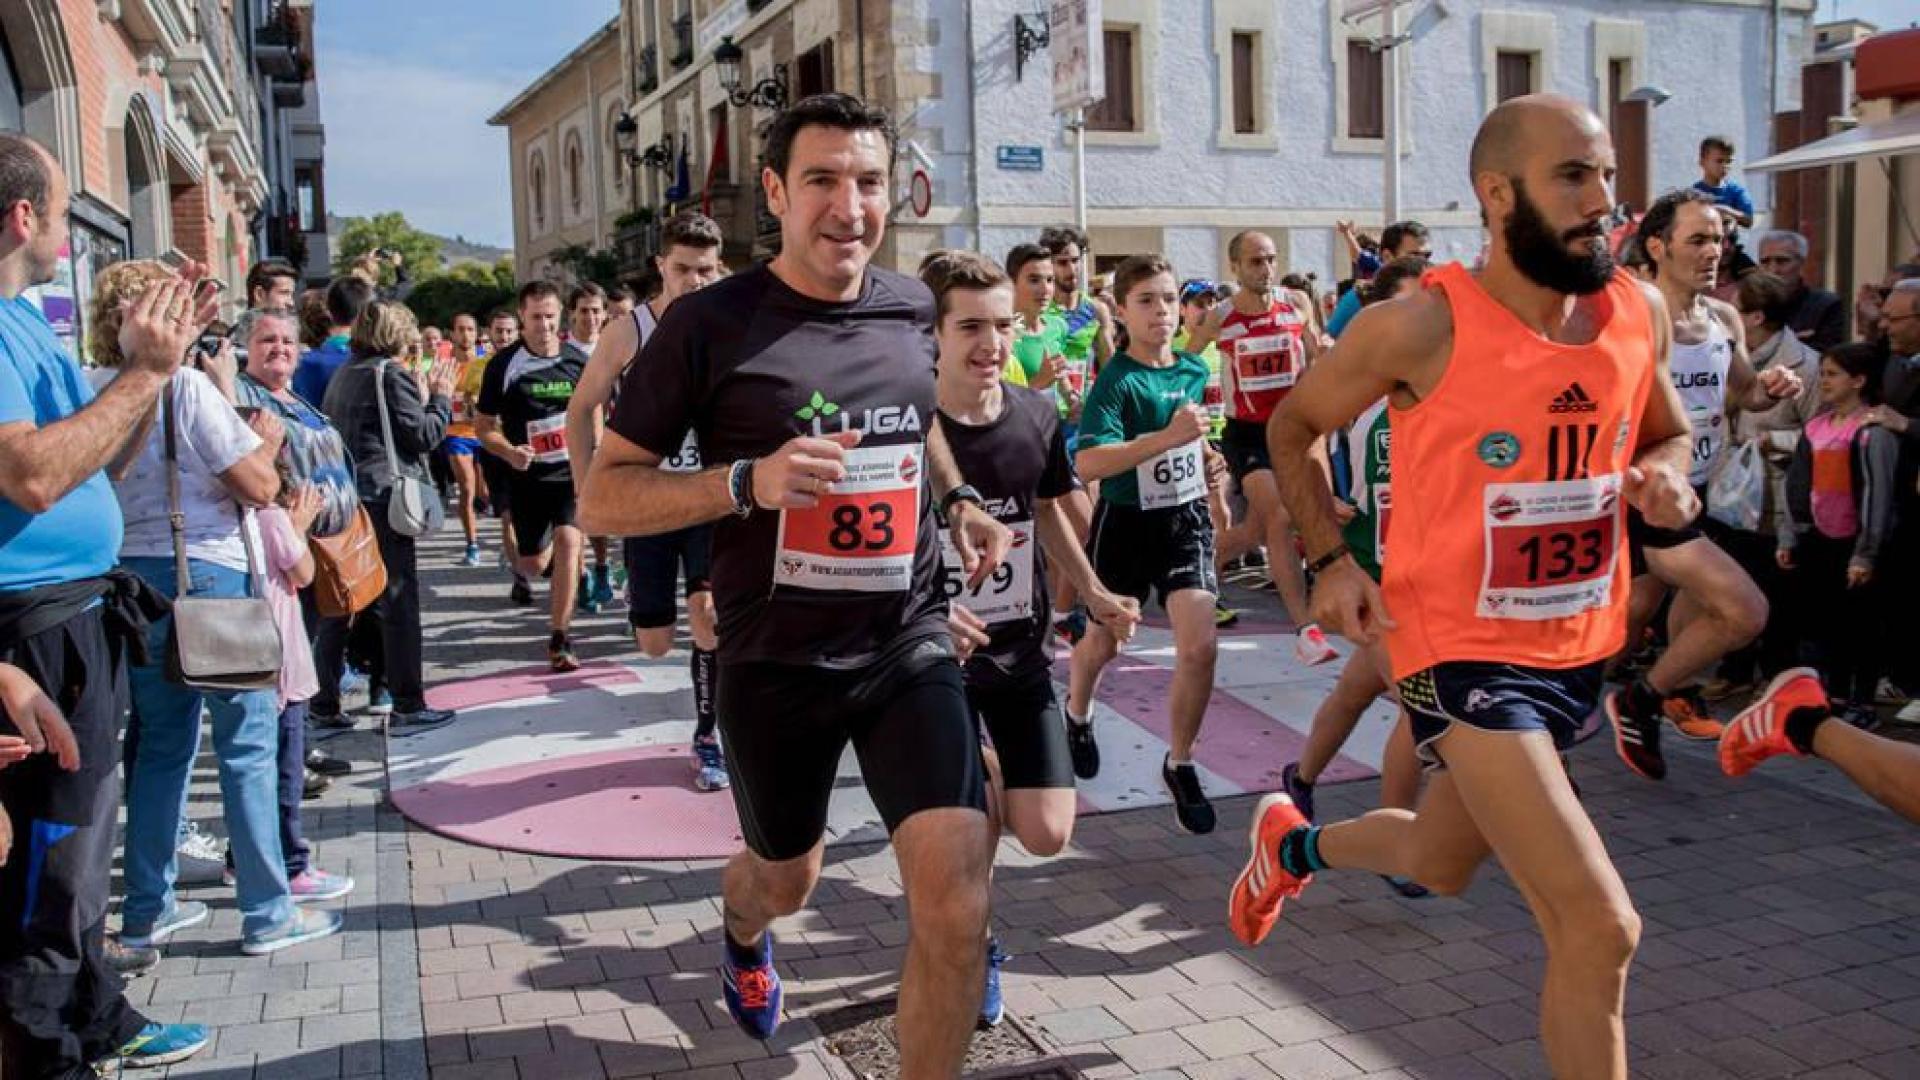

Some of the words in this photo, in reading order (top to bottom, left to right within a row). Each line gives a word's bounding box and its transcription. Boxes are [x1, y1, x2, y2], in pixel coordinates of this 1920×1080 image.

[1251, 353, 1285, 377] 147
[1154, 453, 1195, 484] 658
[829, 502, 894, 550] 83
[1518, 528, 1602, 581] 133
